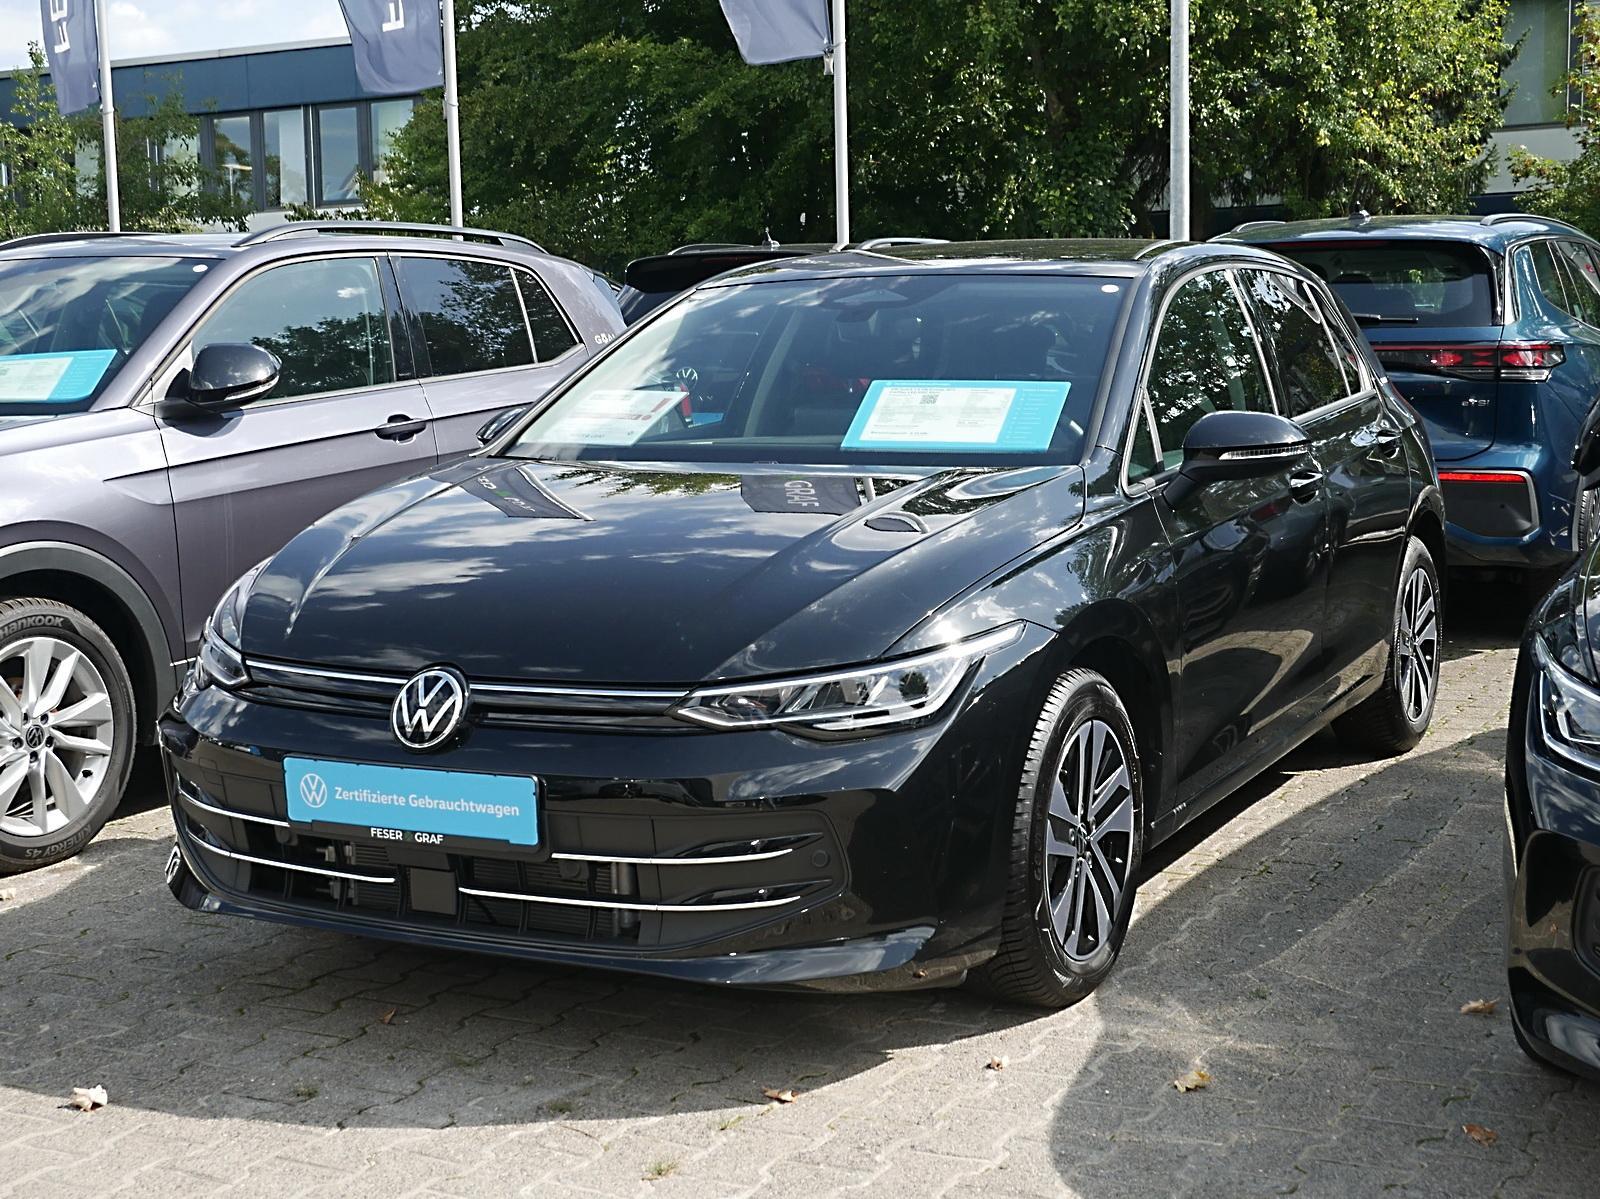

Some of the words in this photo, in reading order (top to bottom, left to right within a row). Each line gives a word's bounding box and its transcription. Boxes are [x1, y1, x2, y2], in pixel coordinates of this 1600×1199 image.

[334, 786, 406, 807] Zertifizierte
[408, 793, 520, 818] Gebrauchtwagen
[370, 827, 403, 841] FESER
[414, 832, 444, 845] GRAF
